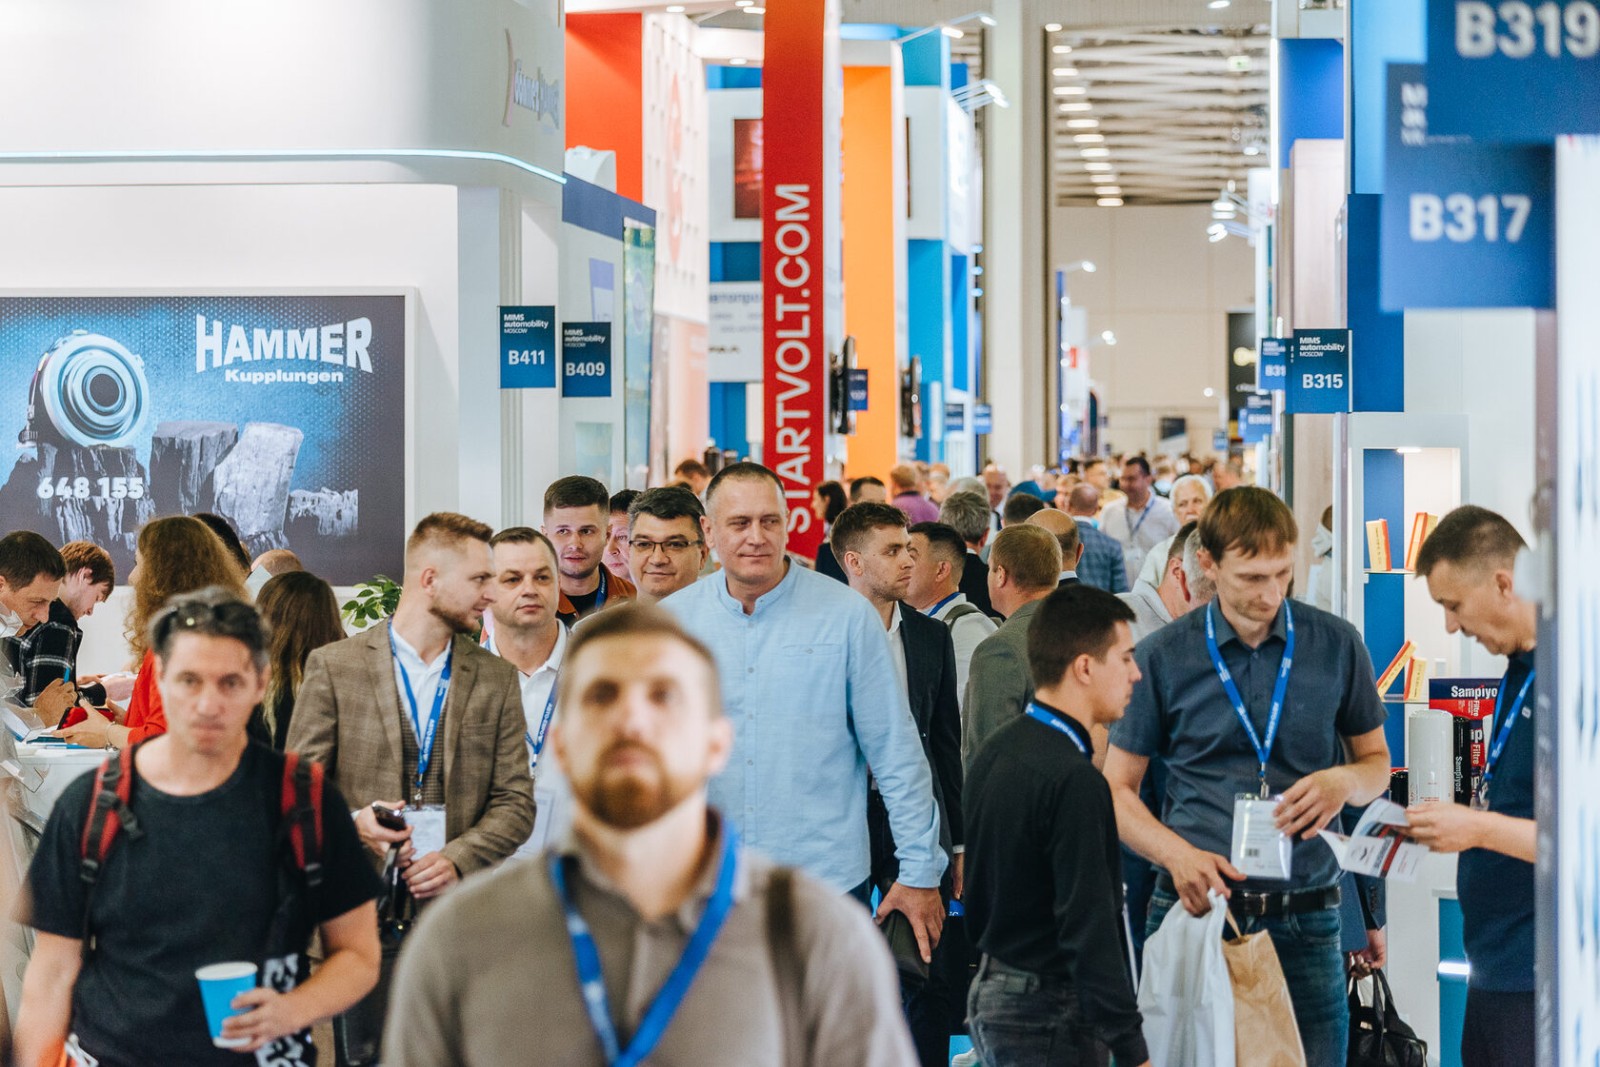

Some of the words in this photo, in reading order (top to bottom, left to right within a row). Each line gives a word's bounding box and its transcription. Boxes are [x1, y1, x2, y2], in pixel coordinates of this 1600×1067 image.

[1455, 1, 1600, 58] B319
[1409, 193, 1532, 242] B317
[504, 319, 549, 329] automobility
[196, 313, 373, 374] HAMMER
[564, 335, 606, 343] automobility
[1299, 344, 1345, 352] automobility
[508, 349, 546, 365] B411
[225, 369, 344, 385] Kupplungen
[565, 362, 606, 377] B409
[1264, 364, 1287, 377] B31
[1302, 373, 1344, 389] B315
[36, 476, 91, 499] 648
[97, 476, 145, 499] 155
[1450, 685, 1498, 700] Sampiyo
[1472, 744, 1481, 765] Filtre
